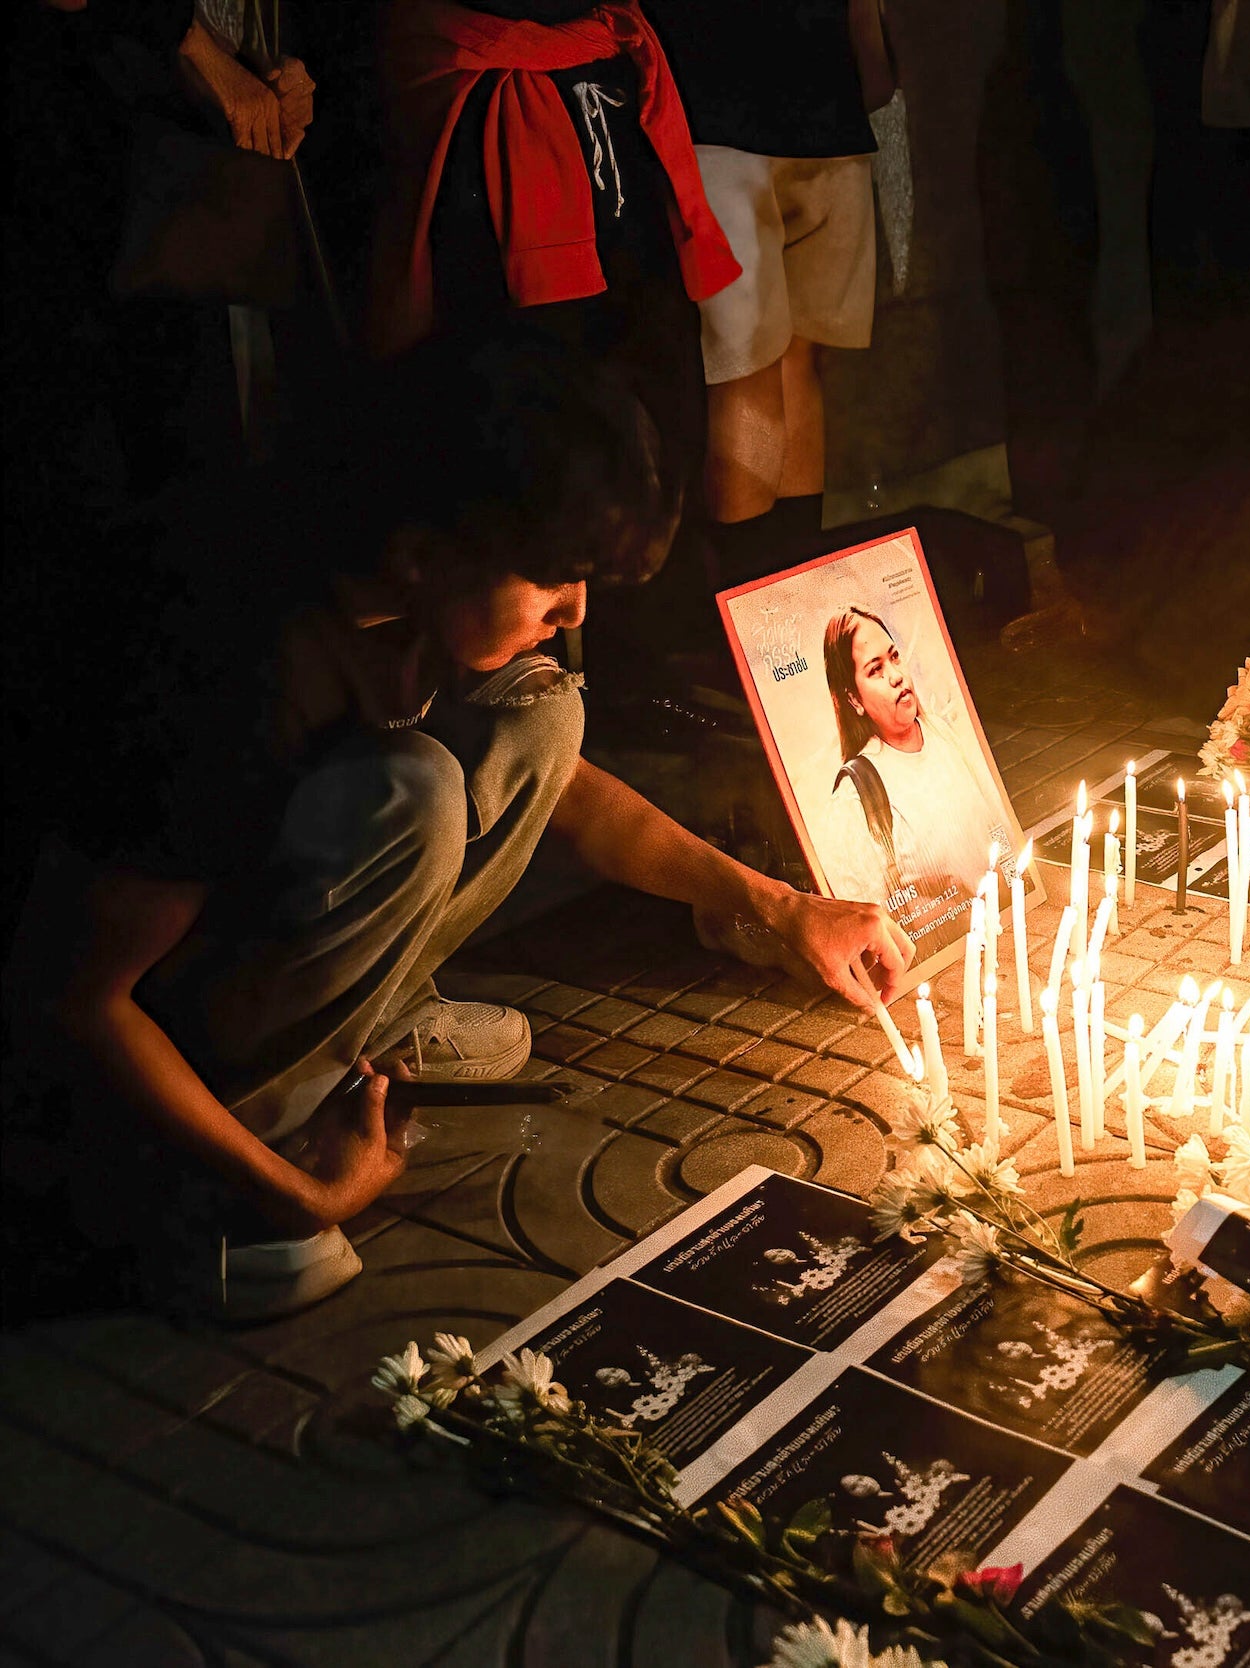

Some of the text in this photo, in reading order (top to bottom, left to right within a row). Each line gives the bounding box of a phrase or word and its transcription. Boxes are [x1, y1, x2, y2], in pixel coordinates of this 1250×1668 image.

[771, 650, 808, 682] ประชาชน
[920, 895, 945, 914] มาตรา
[942, 883, 959, 901] 112
